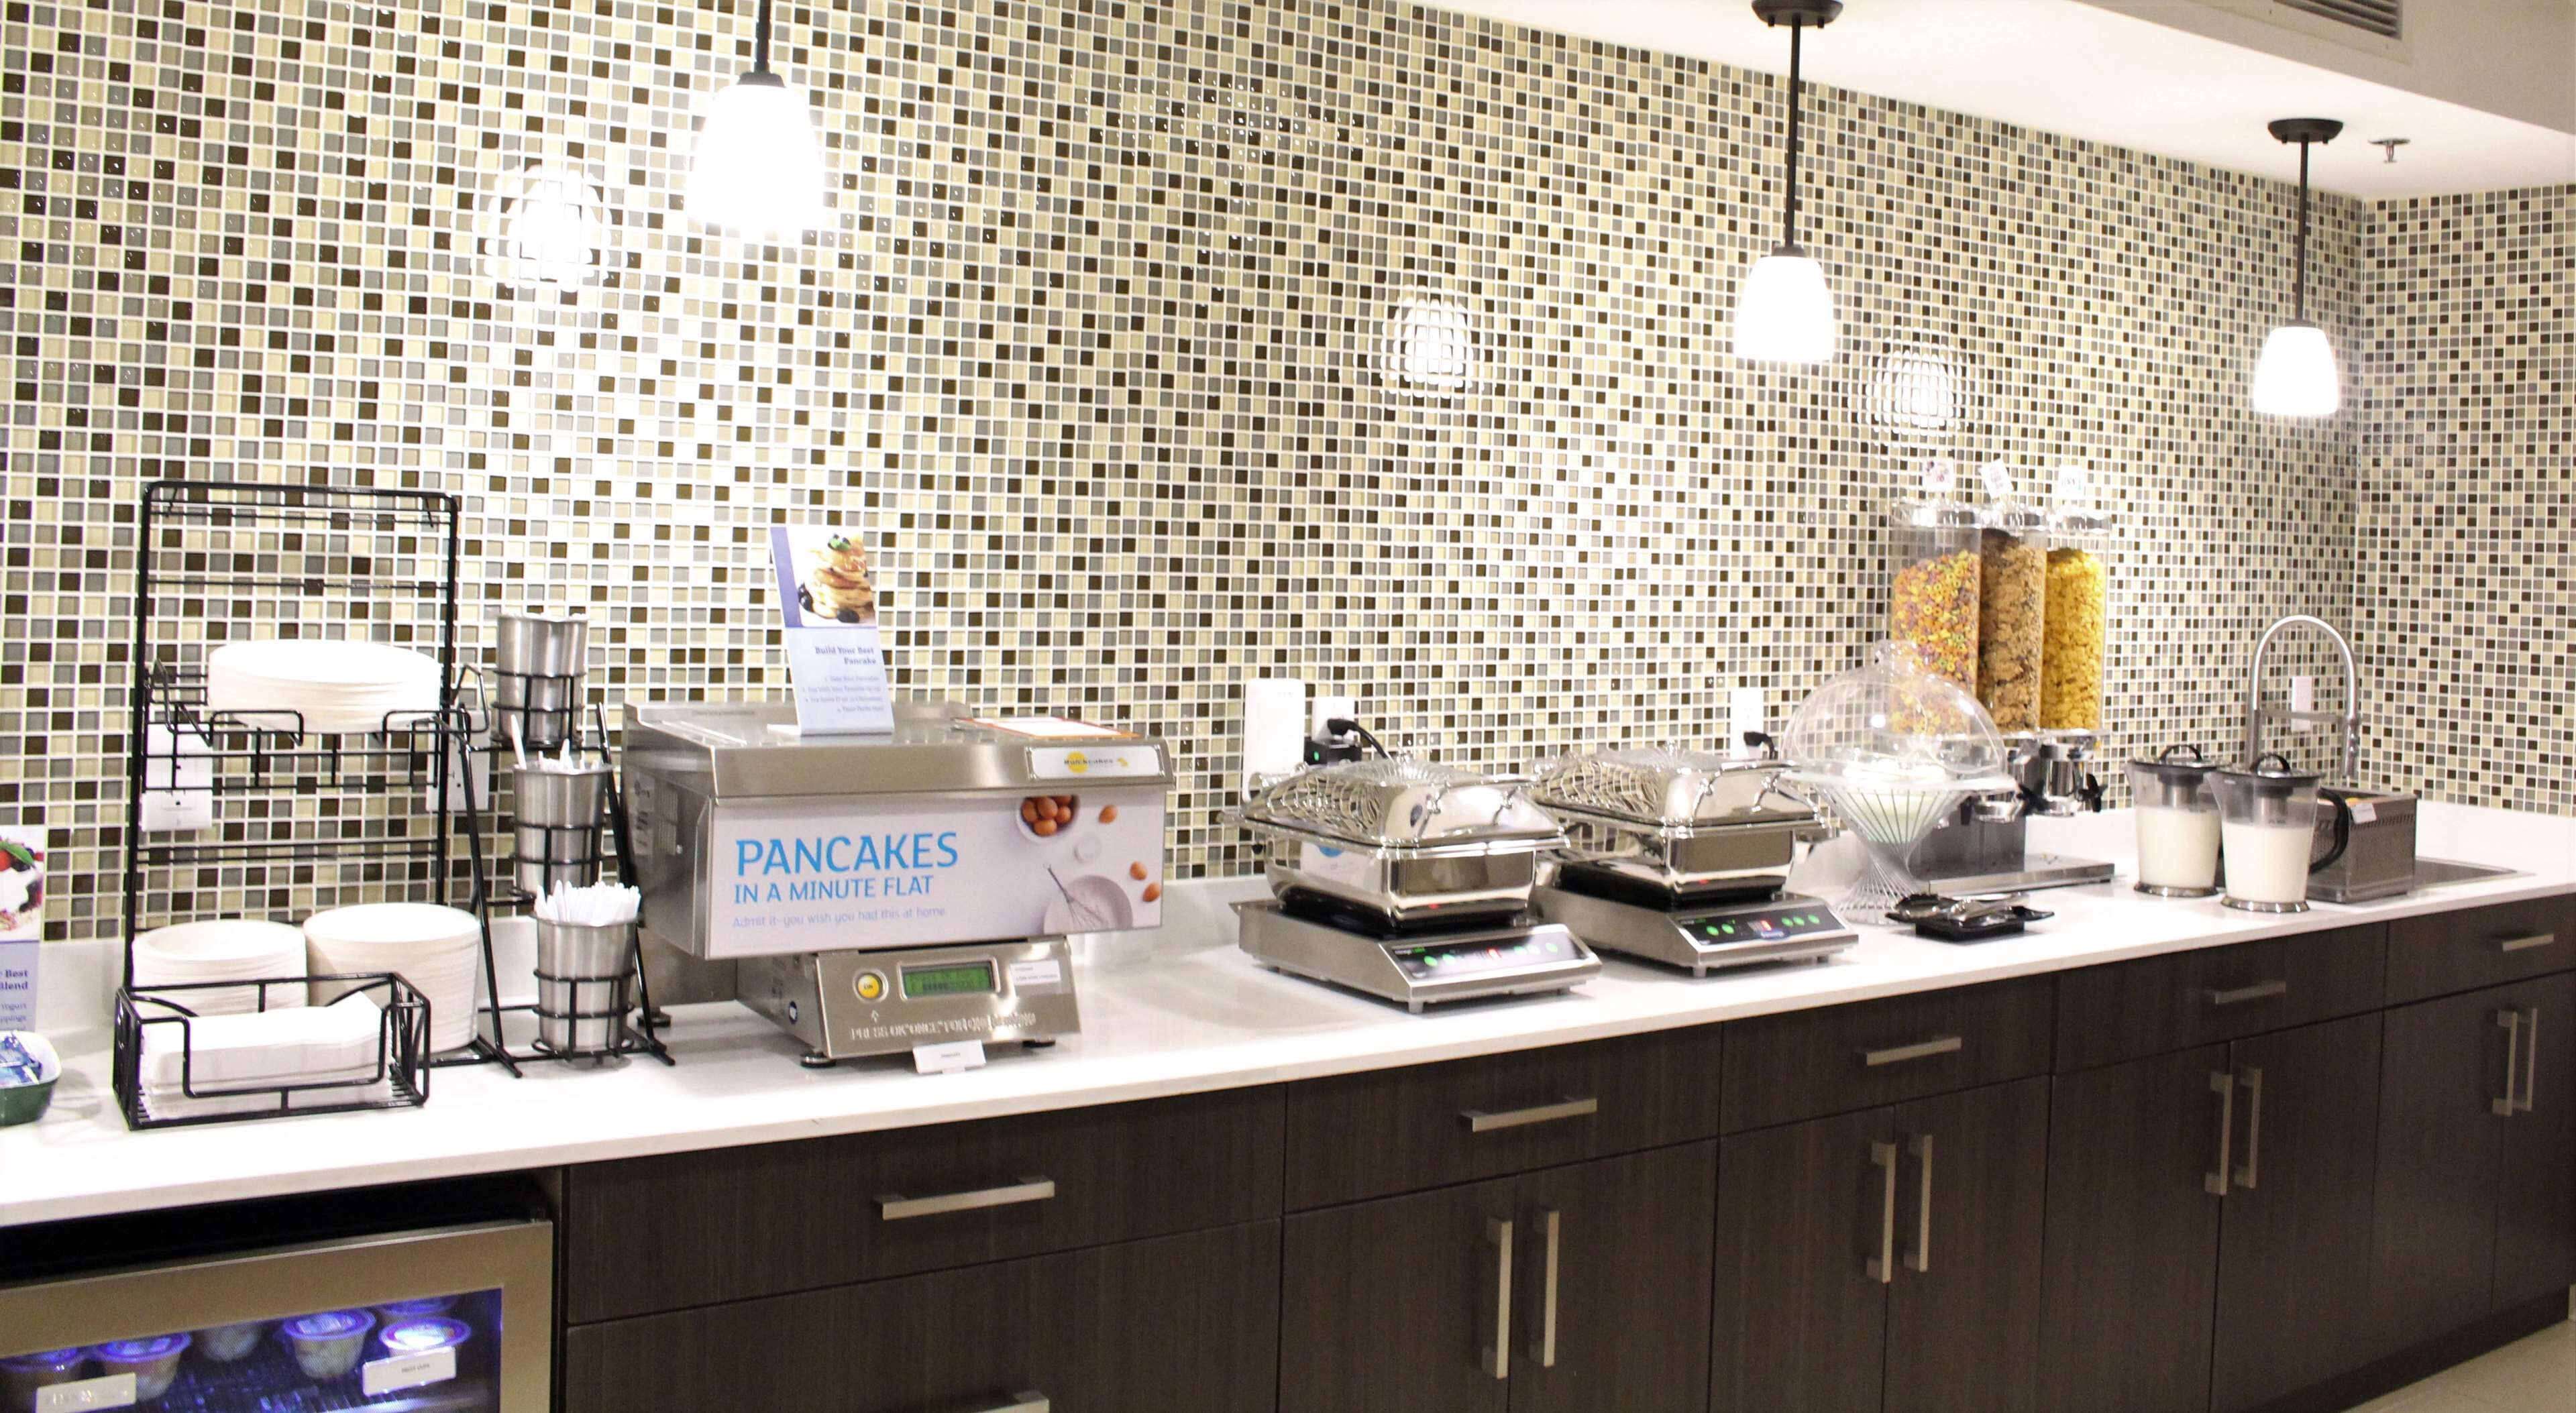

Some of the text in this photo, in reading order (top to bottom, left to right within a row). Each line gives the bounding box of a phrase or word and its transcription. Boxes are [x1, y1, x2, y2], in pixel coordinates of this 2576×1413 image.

[814, 645, 875, 655] Build Your Best
[844, 657, 877, 665] Pancake
[736, 832, 959, 877] PANCAKES
[734, 874, 934, 904] IN A MINUTE FLAT
[732, 916, 765, 927] Admit
[807, 913, 832, 924] wish
[835, 913, 855, 924] you
[858, 909, 877, 921] had
[881, 908, 899, 919] this
[902, 907, 913, 918] at
[5, 969, 28, 978] Best
